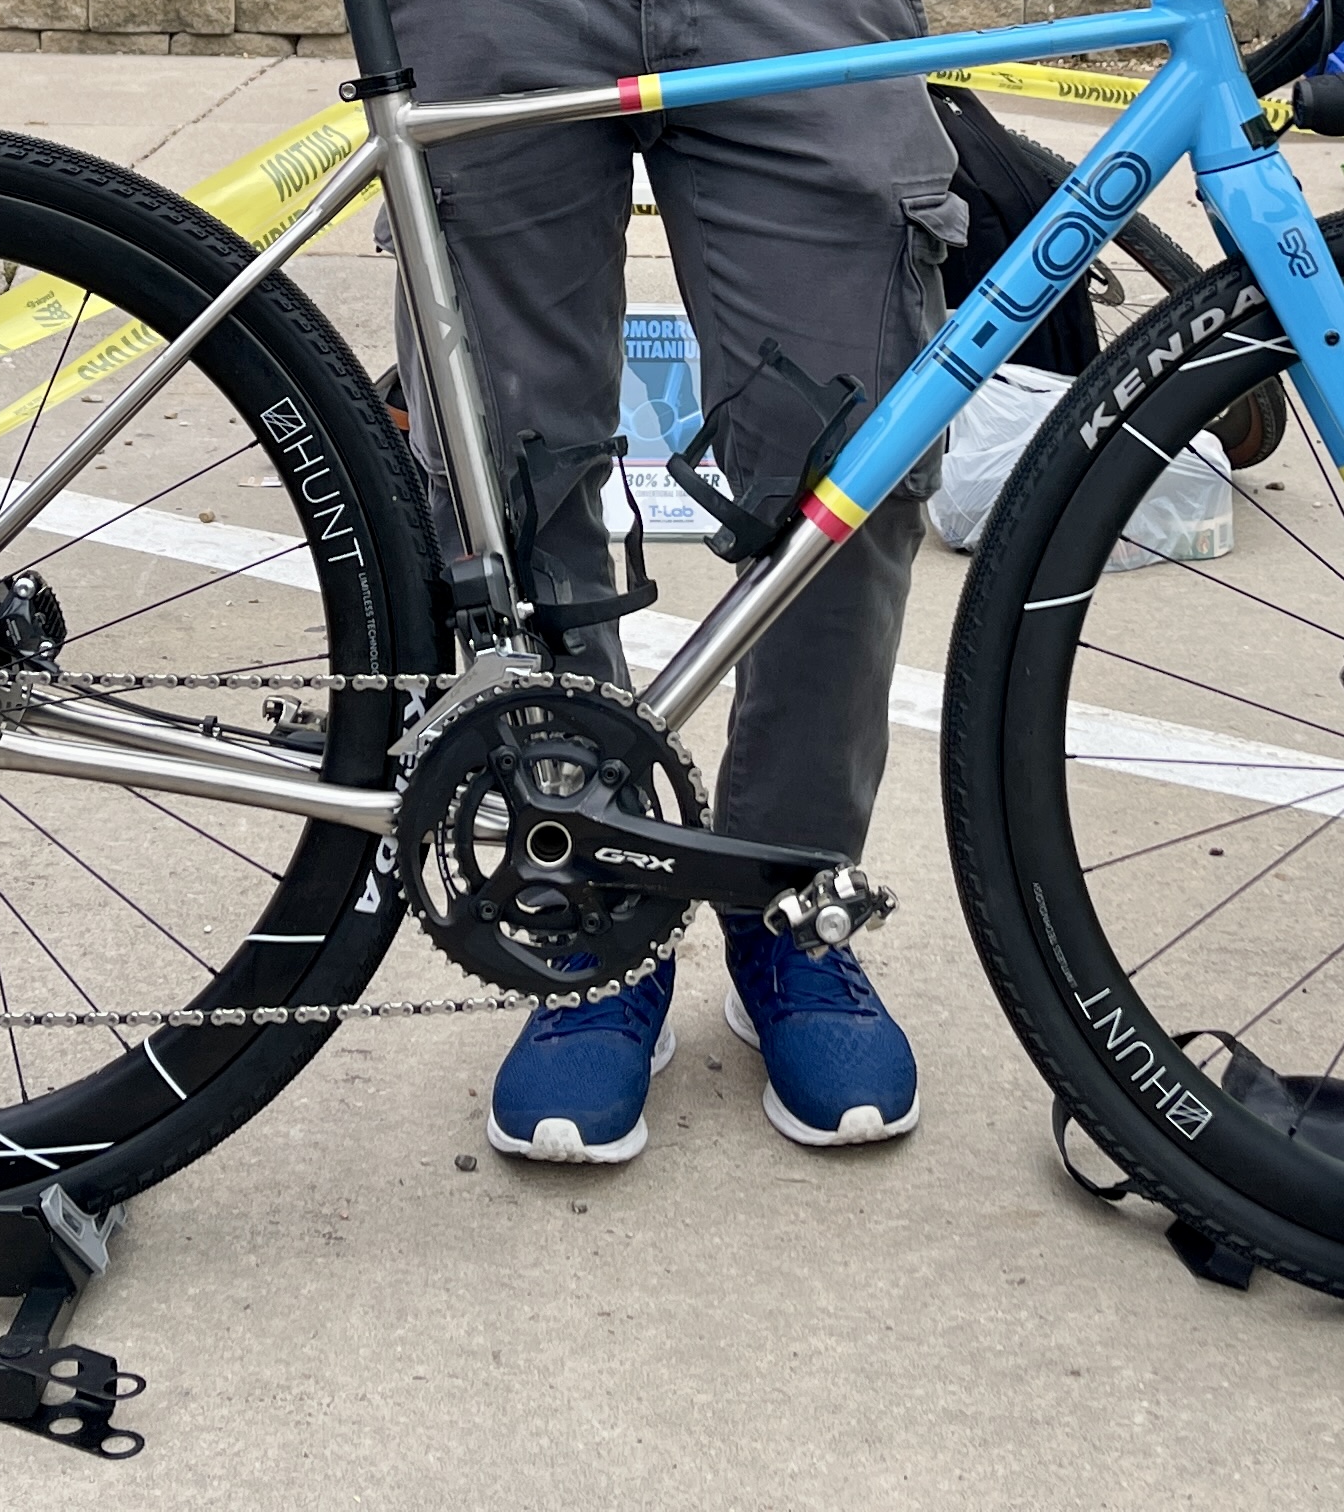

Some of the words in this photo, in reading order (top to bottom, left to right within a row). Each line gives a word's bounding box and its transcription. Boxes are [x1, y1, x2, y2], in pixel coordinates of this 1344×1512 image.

[622, 320, 697, 339] OMORRO
[911, 150, 1152, 392] T-Lab
[1079, 283, 1266, 451] KENDA
[283, 433, 365, 567] HUNT
[594, 847, 676, 874] GRX
[1074, 987, 1182, 1110] HUNT
